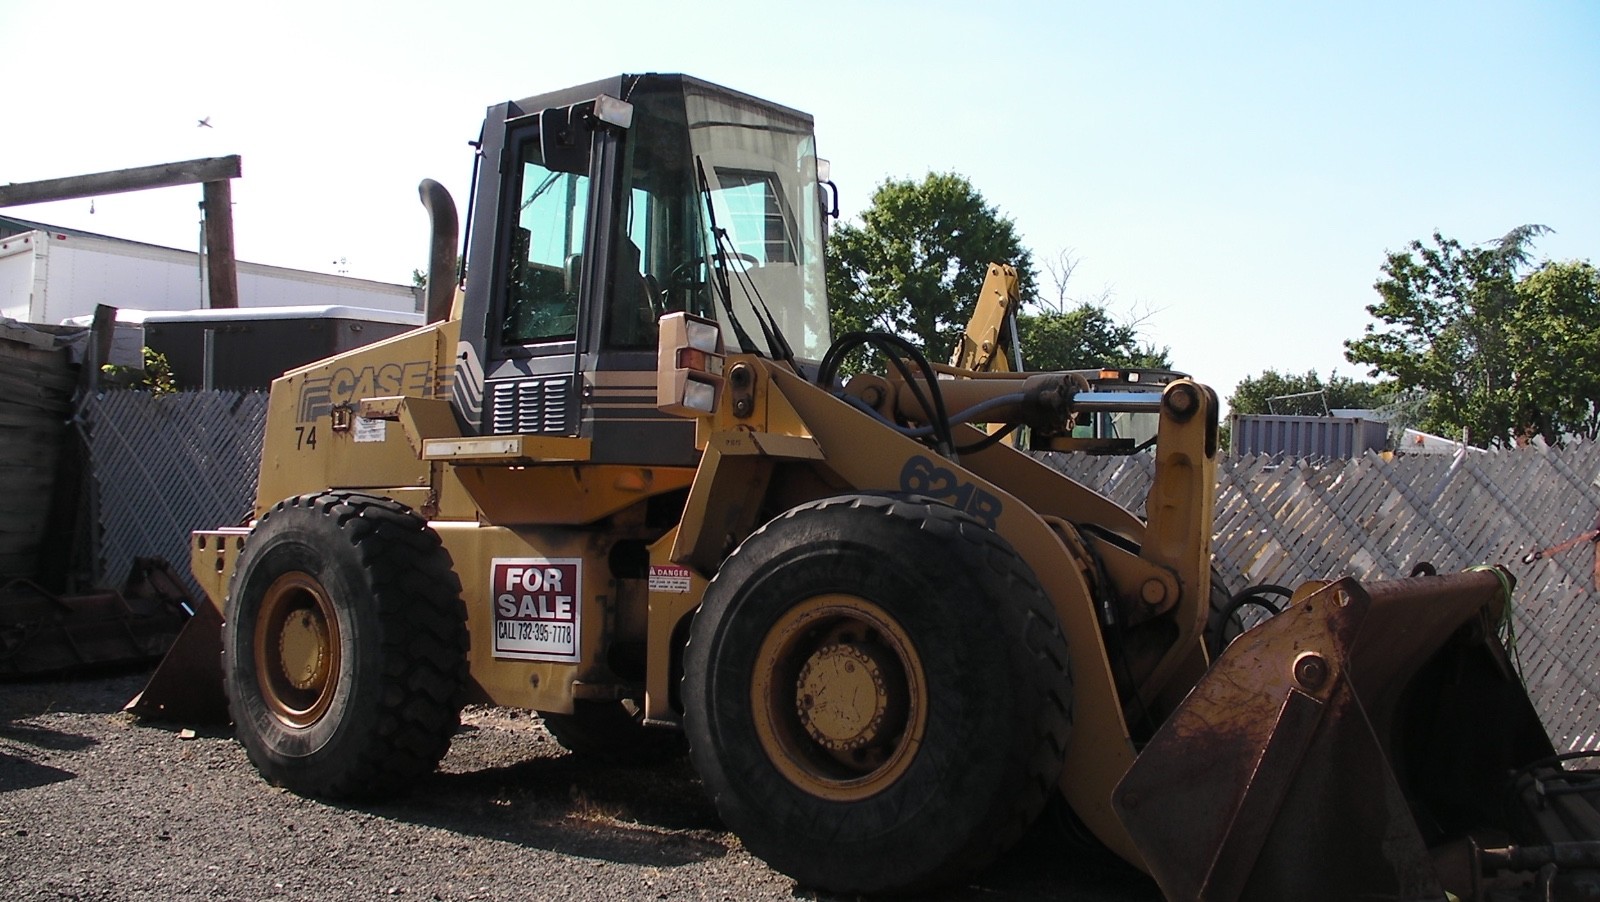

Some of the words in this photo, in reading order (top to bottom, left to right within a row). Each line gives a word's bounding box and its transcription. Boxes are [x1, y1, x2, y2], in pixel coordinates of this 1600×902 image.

[329, 361, 430, 404] CASE
[295, 426, 317, 450] 74
[506, 568, 562, 592] FOR
[657, 569, 689, 577] DANGER
[498, 594, 572, 619] SALE
[498, 621, 516, 640] CALL
[518, 622, 572, 644] 732-395-7778
